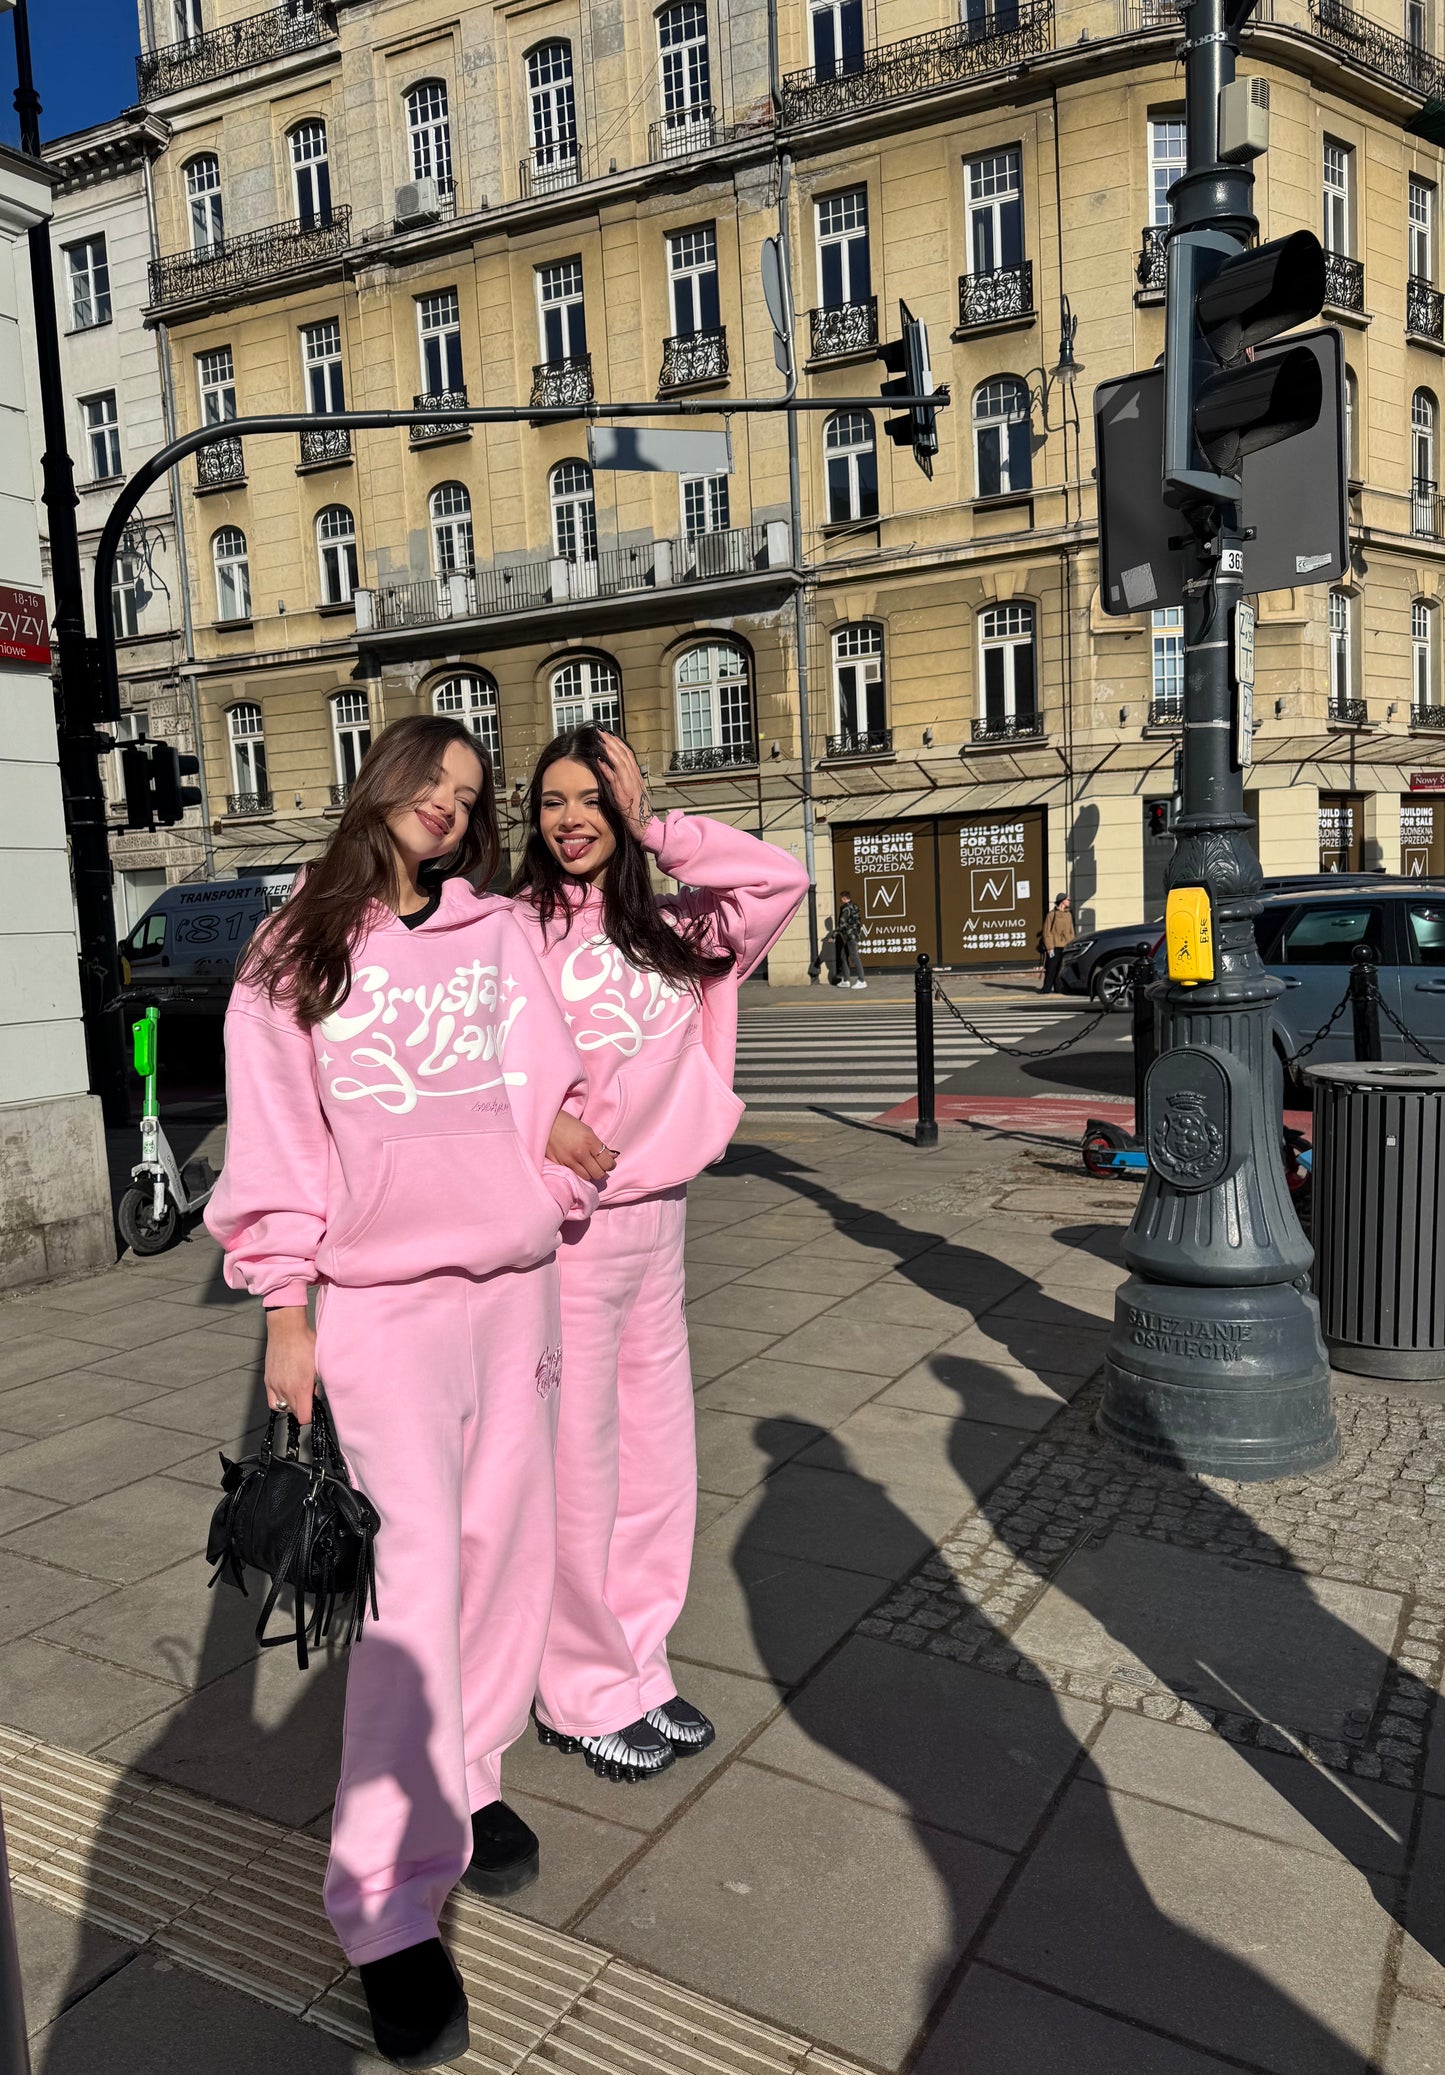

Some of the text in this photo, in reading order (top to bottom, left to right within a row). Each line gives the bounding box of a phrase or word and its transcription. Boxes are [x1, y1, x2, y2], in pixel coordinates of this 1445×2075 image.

[12, 592, 39, 608] 18-16
[1415, 776, 1438, 786] Nowy
[1400, 807, 1433, 817] BUILDING
[1400, 816, 1433, 826] FOR SALE
[959, 823, 1024, 838] BUILDING
[853, 832, 914, 846] BUILDING
[960, 833, 1024, 848] FOR SALE
[1400, 835, 1433, 845] SPRZEDAŻ
[854, 842, 914, 856] FOR SALE
[960, 844, 1024, 857] BUDYNEK NA
[854, 852, 914, 865] BUDYNEK NA
[960, 853, 1025, 867] SPRZEDAŻ
[854, 861, 914, 874] SPRZEDAŻ
[180, 887, 252, 904] TRANSPORT
[875, 924, 916, 934] NAVIMO
[982, 918, 1026, 928] NAVIMO
[962, 934, 977, 942] +48
[978, 933, 992, 941] 691
[978, 941, 994, 949] 609
[319, 958, 499, 1047] Crysta
[1128, 1307, 1253, 1342] SALEZJANIE
[1133, 1330, 1243, 1361] OŚWIĘCIM
